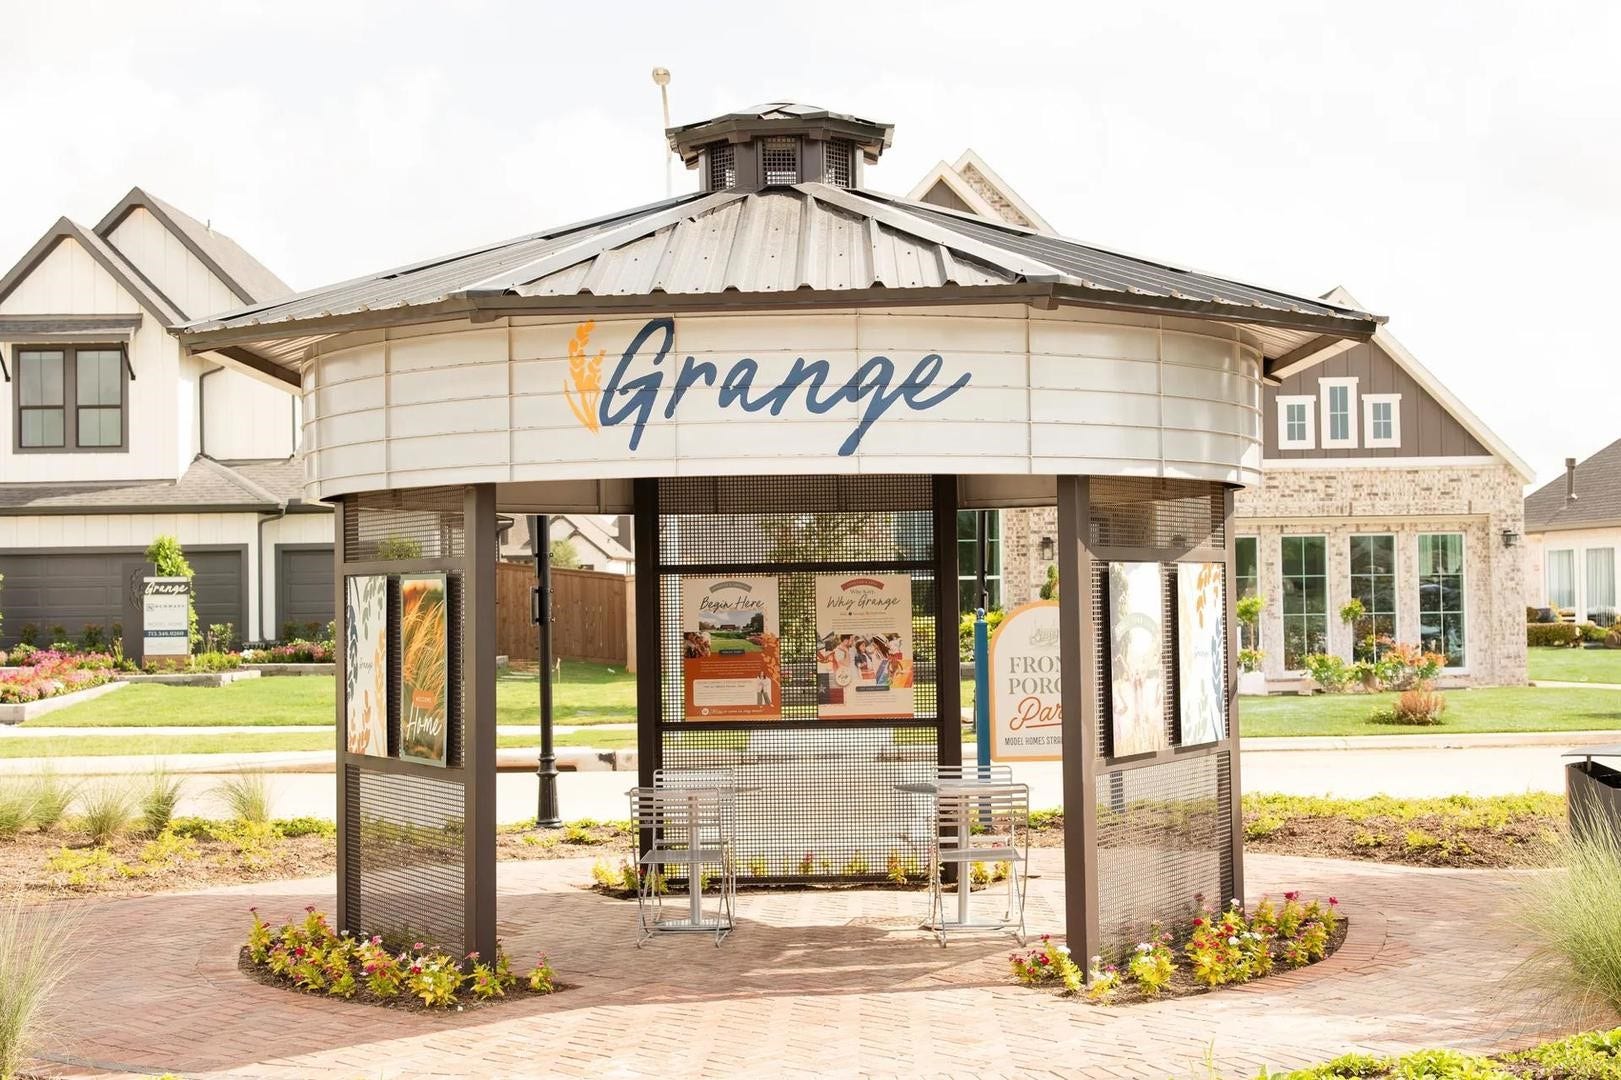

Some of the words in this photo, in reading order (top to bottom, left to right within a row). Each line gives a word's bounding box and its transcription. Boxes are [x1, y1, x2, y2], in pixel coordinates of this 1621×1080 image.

[600, 316, 972, 457] Grange
[145, 582, 188, 597] Grange
[700, 596, 732, 613] Begin
[735, 595, 765, 610] Here
[827, 596, 855, 610] Why
[857, 594, 901, 610] Grange
[406, 701, 442, 741] Home
[1004, 737, 1024, 746] MODEL
[1025, 736, 1046, 745] HOMES
[1046, 735, 1062, 744] STRA
